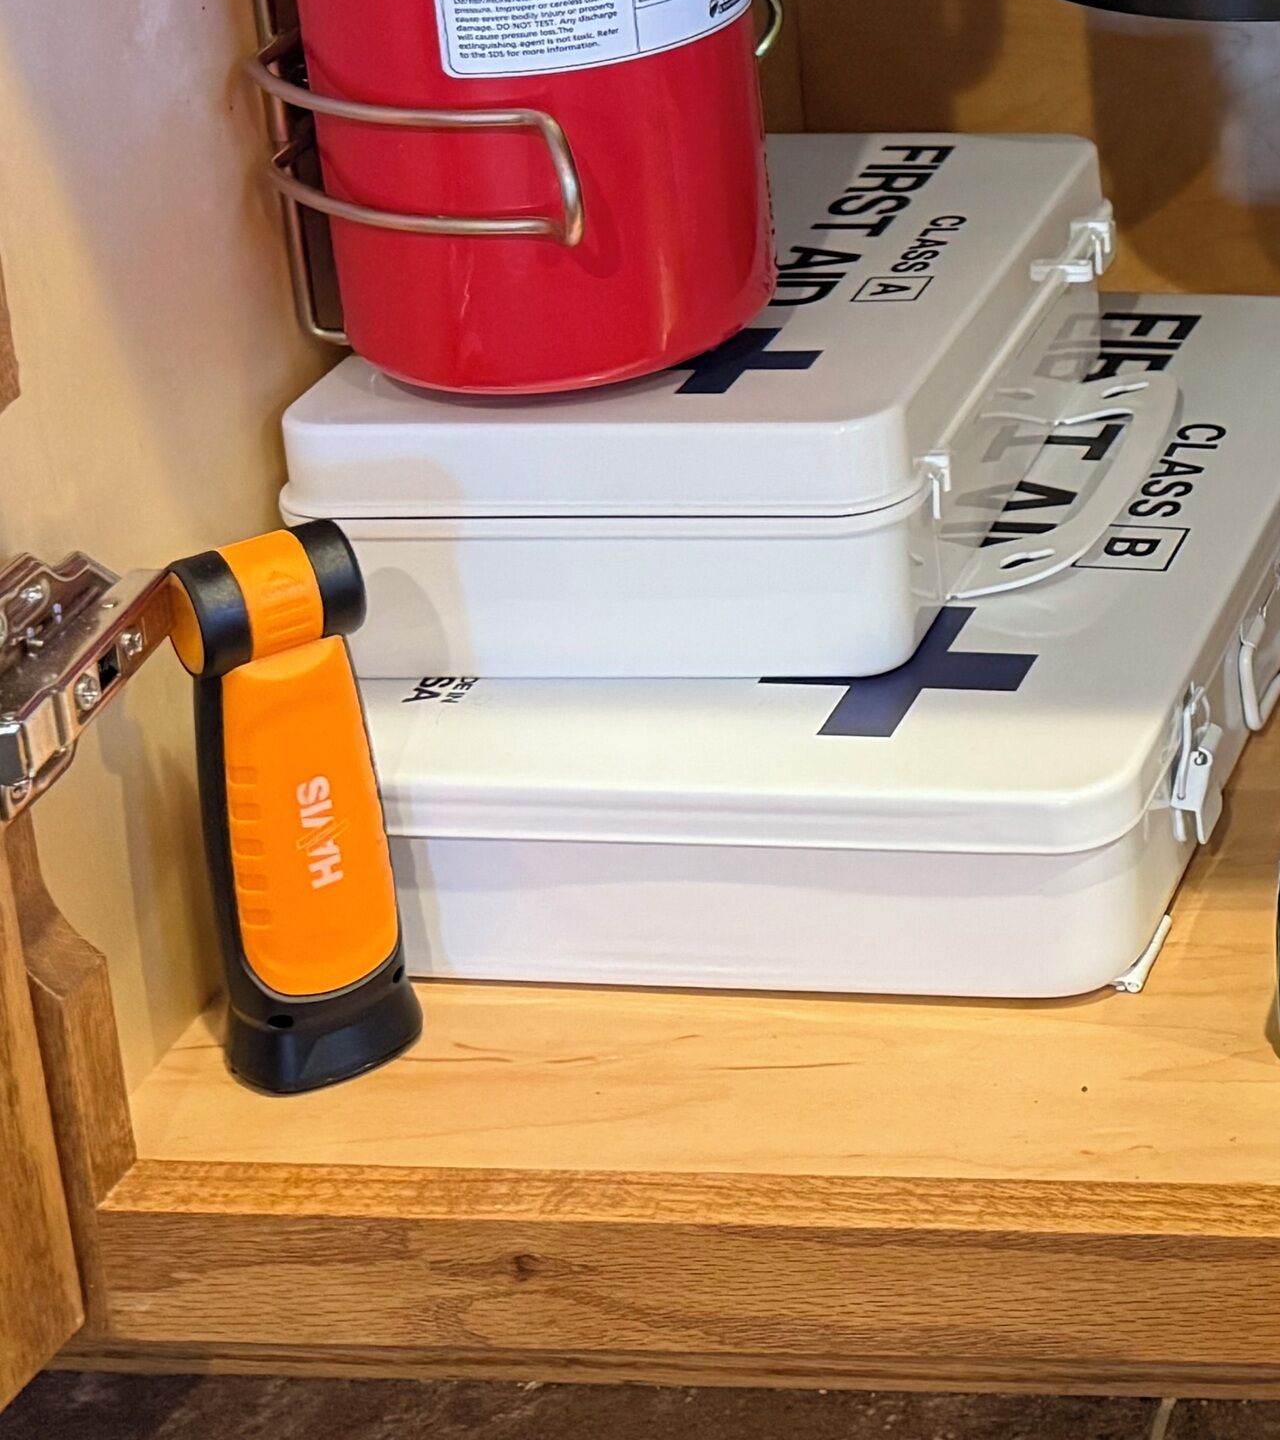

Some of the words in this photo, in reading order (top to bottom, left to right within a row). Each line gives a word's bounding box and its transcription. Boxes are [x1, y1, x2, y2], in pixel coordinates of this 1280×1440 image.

[458, 41, 517, 51] extinguishing
[520, 39, 545, 48] agent
[573, 33, 595, 42] toxic.
[597, 27, 619, 37] Refer
[459, 51, 470, 59] to
[471, 51, 486, 59] the
[488, 50, 505, 59] SDS
[506, 49, 520, 58] for
[522, 48, 545, 56] more
[547, 41, 600, 53] information.
[812, 144, 957, 237] FIRST
[890, 214, 968, 274] CLASS
[766, 245, 863, 307] AID
[868, 281, 912, 297] A
[1044, 312, 1203, 461] FIRT
[1128, 423, 1227, 518] CLASS
[980, 480, 1079, 548] AI
[1103, 536, 1161, 558] B
